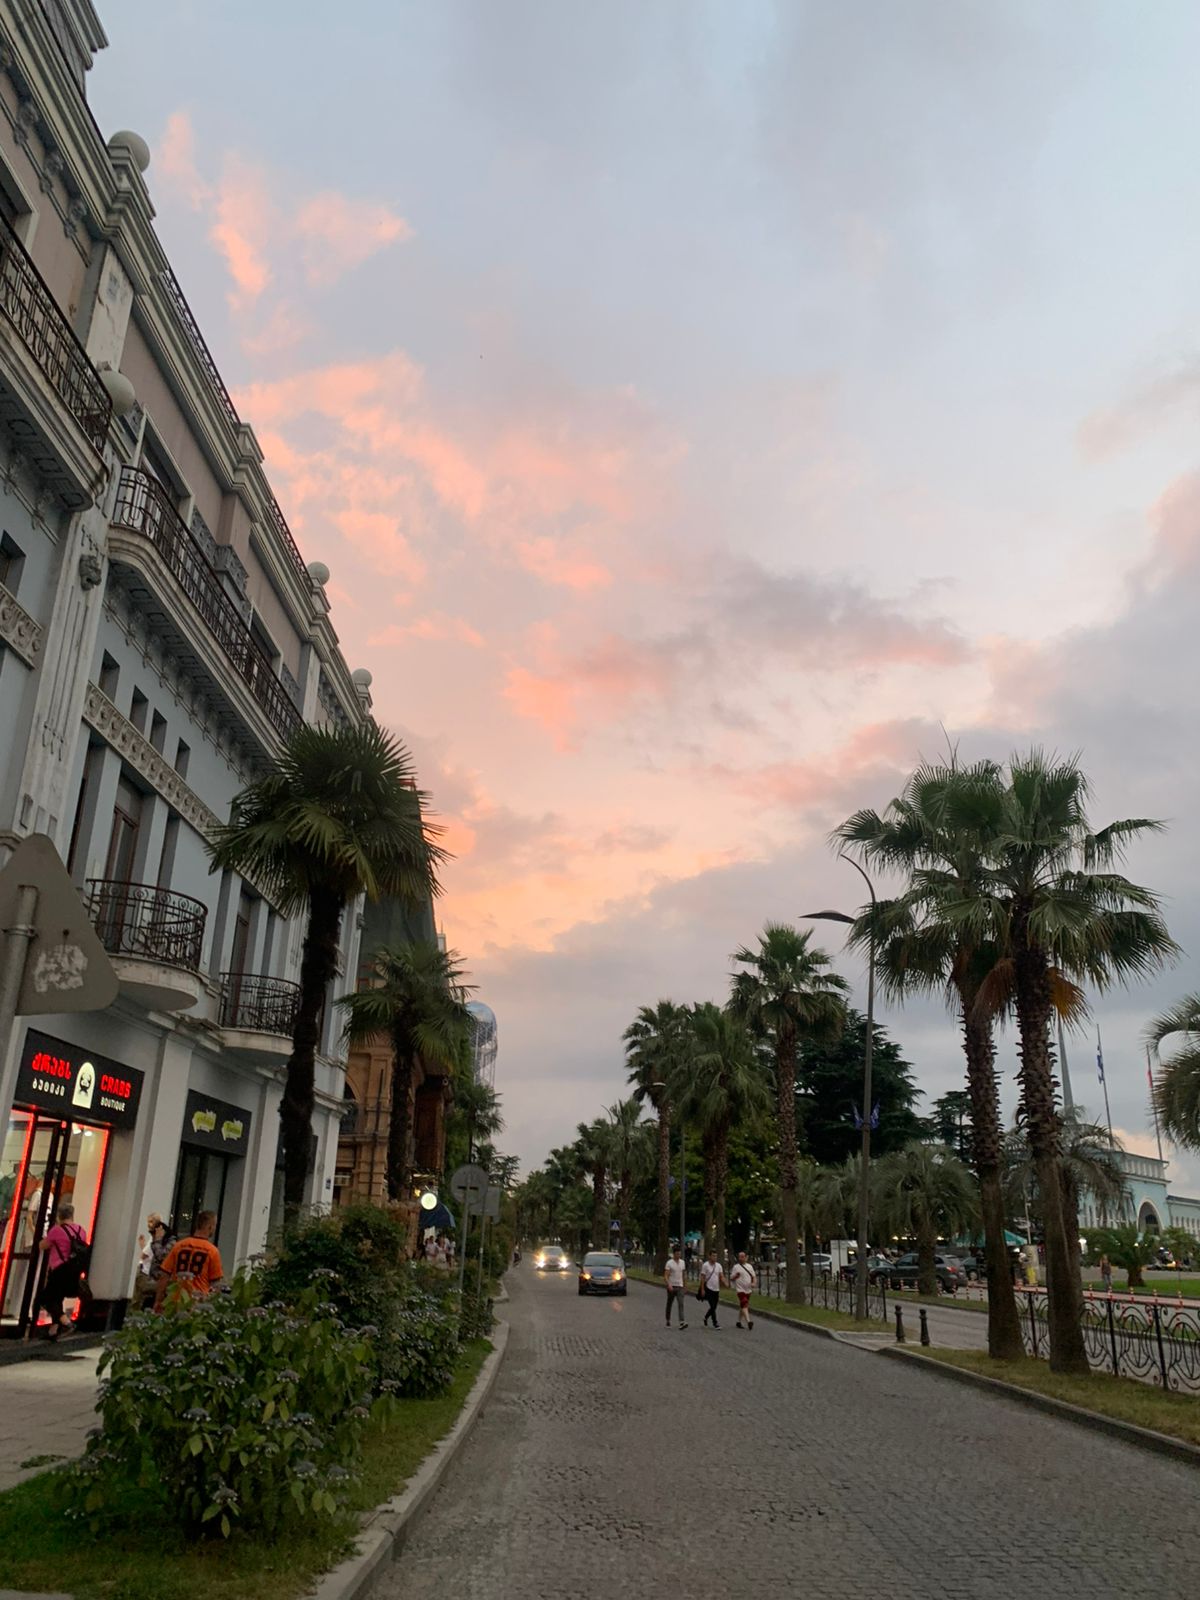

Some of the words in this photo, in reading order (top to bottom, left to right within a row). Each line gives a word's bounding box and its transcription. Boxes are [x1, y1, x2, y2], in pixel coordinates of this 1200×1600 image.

[100, 1074, 131, 1099] CRABS
[100, 1096, 126, 1112] BOUTIQUE
[176, 1249, 208, 1276] 88
